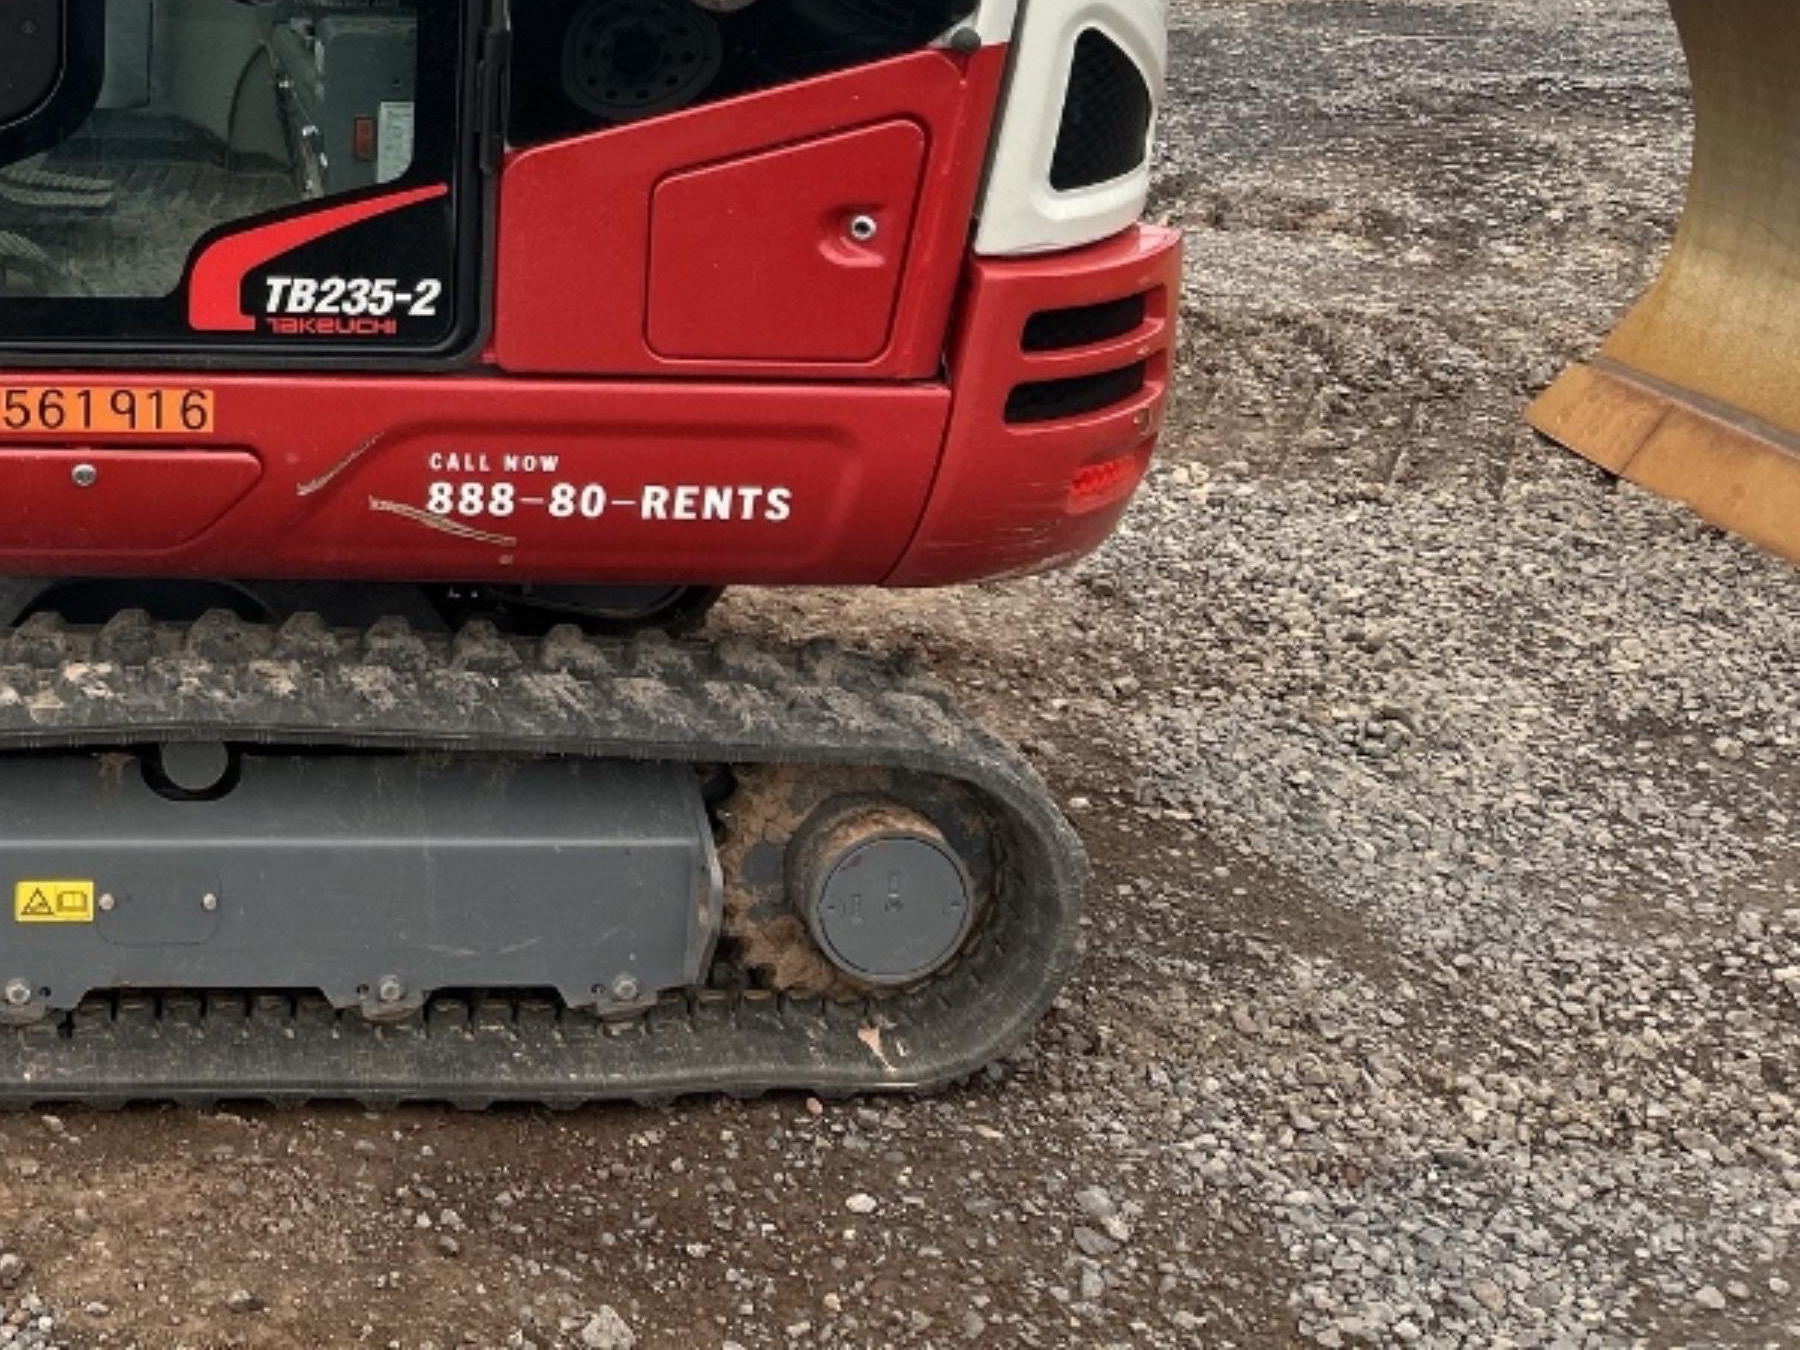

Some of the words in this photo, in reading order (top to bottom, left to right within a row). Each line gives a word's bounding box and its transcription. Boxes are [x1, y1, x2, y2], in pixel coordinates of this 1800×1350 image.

[265, 276, 442, 317] TB235-2
[2, 388, 208, 430] 561916
[429, 452, 491, 472] CALL
[503, 454, 559, 473] NOW
[426, 481, 793, 521] 888-80-RENTS
